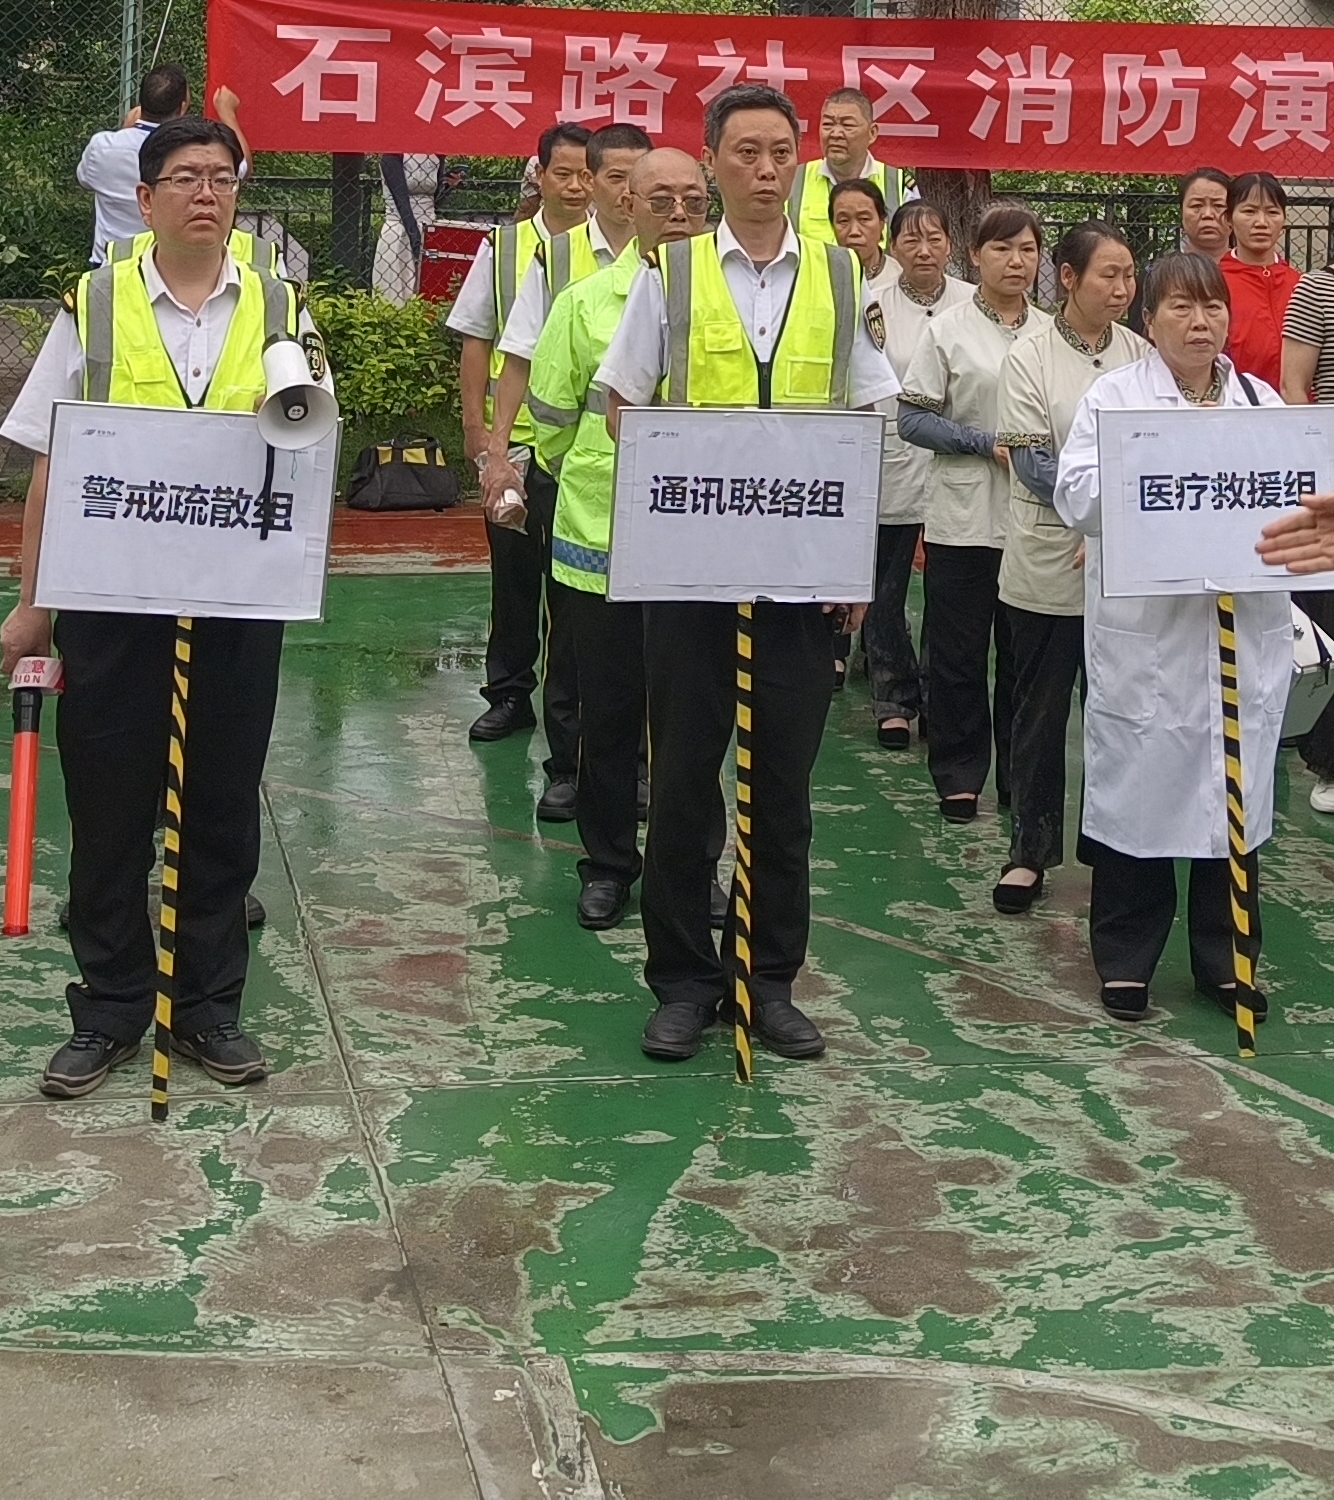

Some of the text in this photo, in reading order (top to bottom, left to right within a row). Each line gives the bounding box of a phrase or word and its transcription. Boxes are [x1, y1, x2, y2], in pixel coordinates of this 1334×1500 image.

[81, 474, 294, 532] 警戒疏散组
[648, 475, 845, 518] 通讯联络组
[1139, 470, 1316, 511] 医疗救援组
